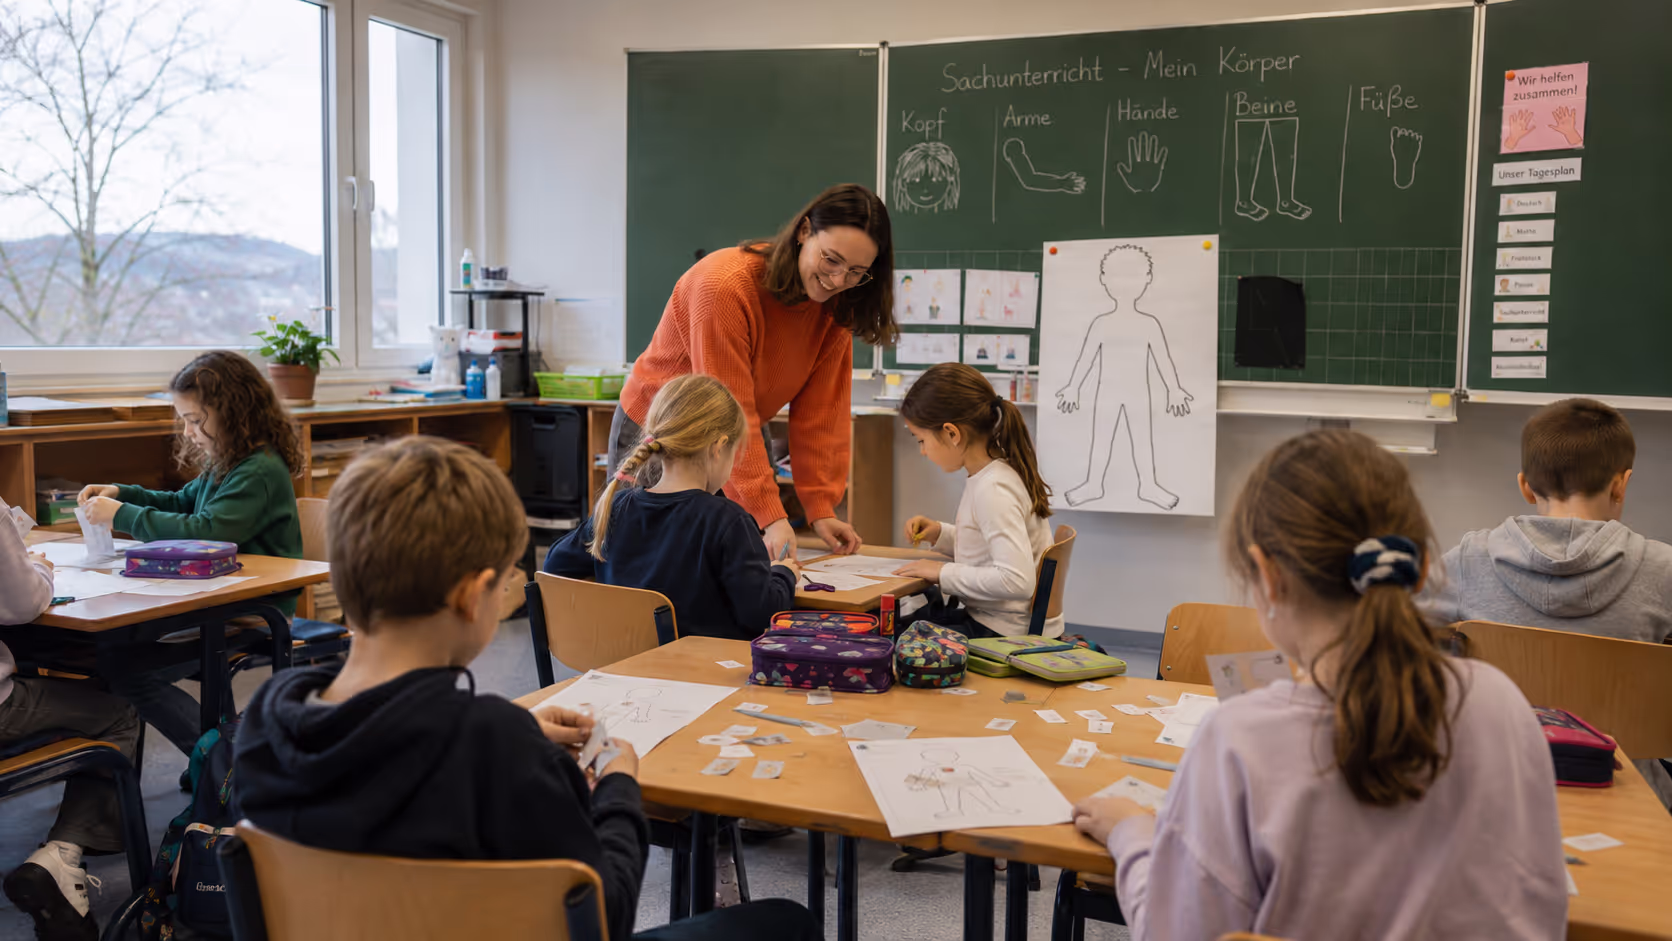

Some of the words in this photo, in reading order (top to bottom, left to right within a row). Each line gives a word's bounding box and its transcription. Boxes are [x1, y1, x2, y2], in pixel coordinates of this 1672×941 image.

[941, 56, 1103, 93] Sachunterricht
[1144, 50, 1197, 80] Mein
[1219, 46, 1300, 82] Körper
[1518, 75, 1537, 86] Wir
[1540, 71, 1574, 84] helfen
[1234, 90, 1298, 116] Beine
[1360, 84, 1419, 118] Füße
[1513, 84, 1578, 101] zusammen!
[1003, 104, 1053, 128] Arme
[1117, 96, 1180, 122] Hände
[901, 107, 947, 141] Kopf
[1498, 169, 1525, 179] Unser
[1528, 166, 1575, 180] Tagesplan
